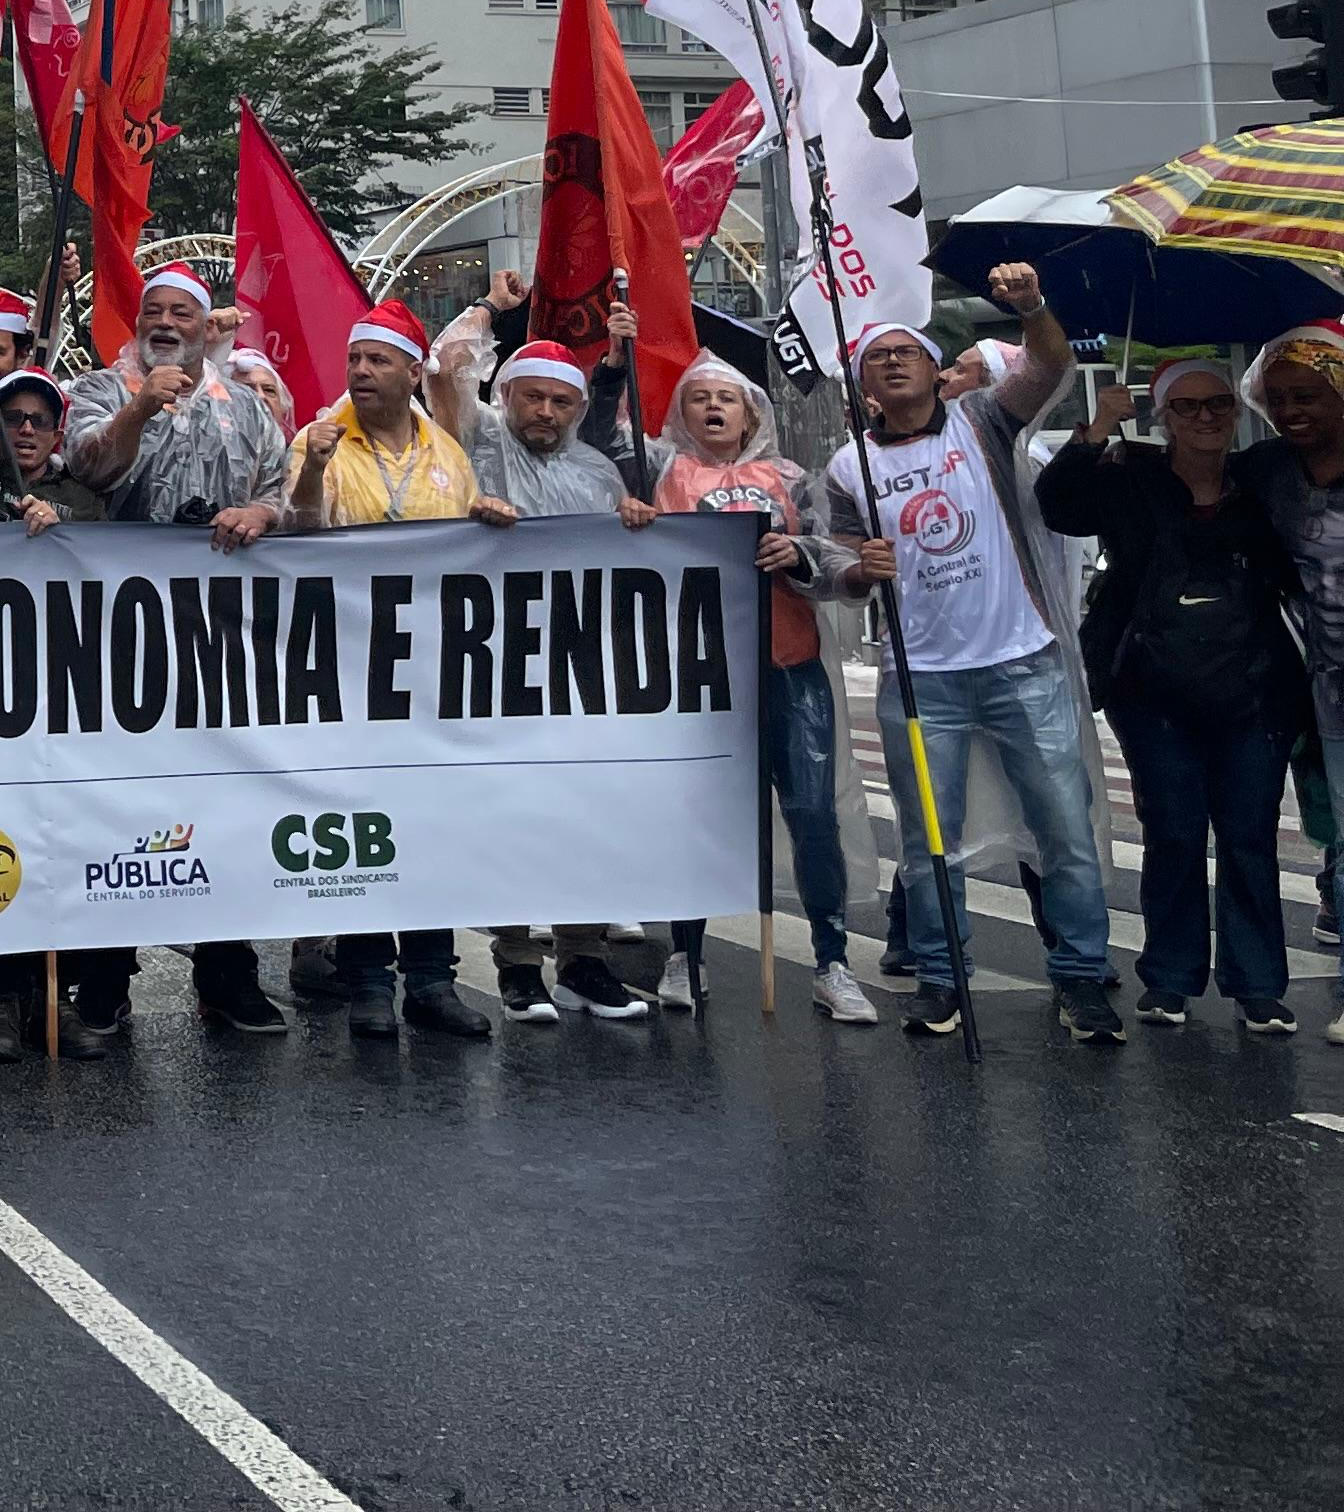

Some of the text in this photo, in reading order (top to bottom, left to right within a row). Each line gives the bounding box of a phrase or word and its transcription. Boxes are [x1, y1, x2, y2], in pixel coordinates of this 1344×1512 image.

[829, 223, 877, 298] DOS
[774, 320, 813, 375] UGT
[367, 573, 413, 721] E
[437, 565, 733, 720] RENDA
[271, 811, 396, 873] CSB
[85, 855, 209, 890] PÚBLICA
[86, 887, 211, 901] CENTRAL DO SERVIDOR
[273, 872, 399, 888] CENTRAL DOS SINDICATOS
[307, 887, 366, 899] BRASILEIROS
